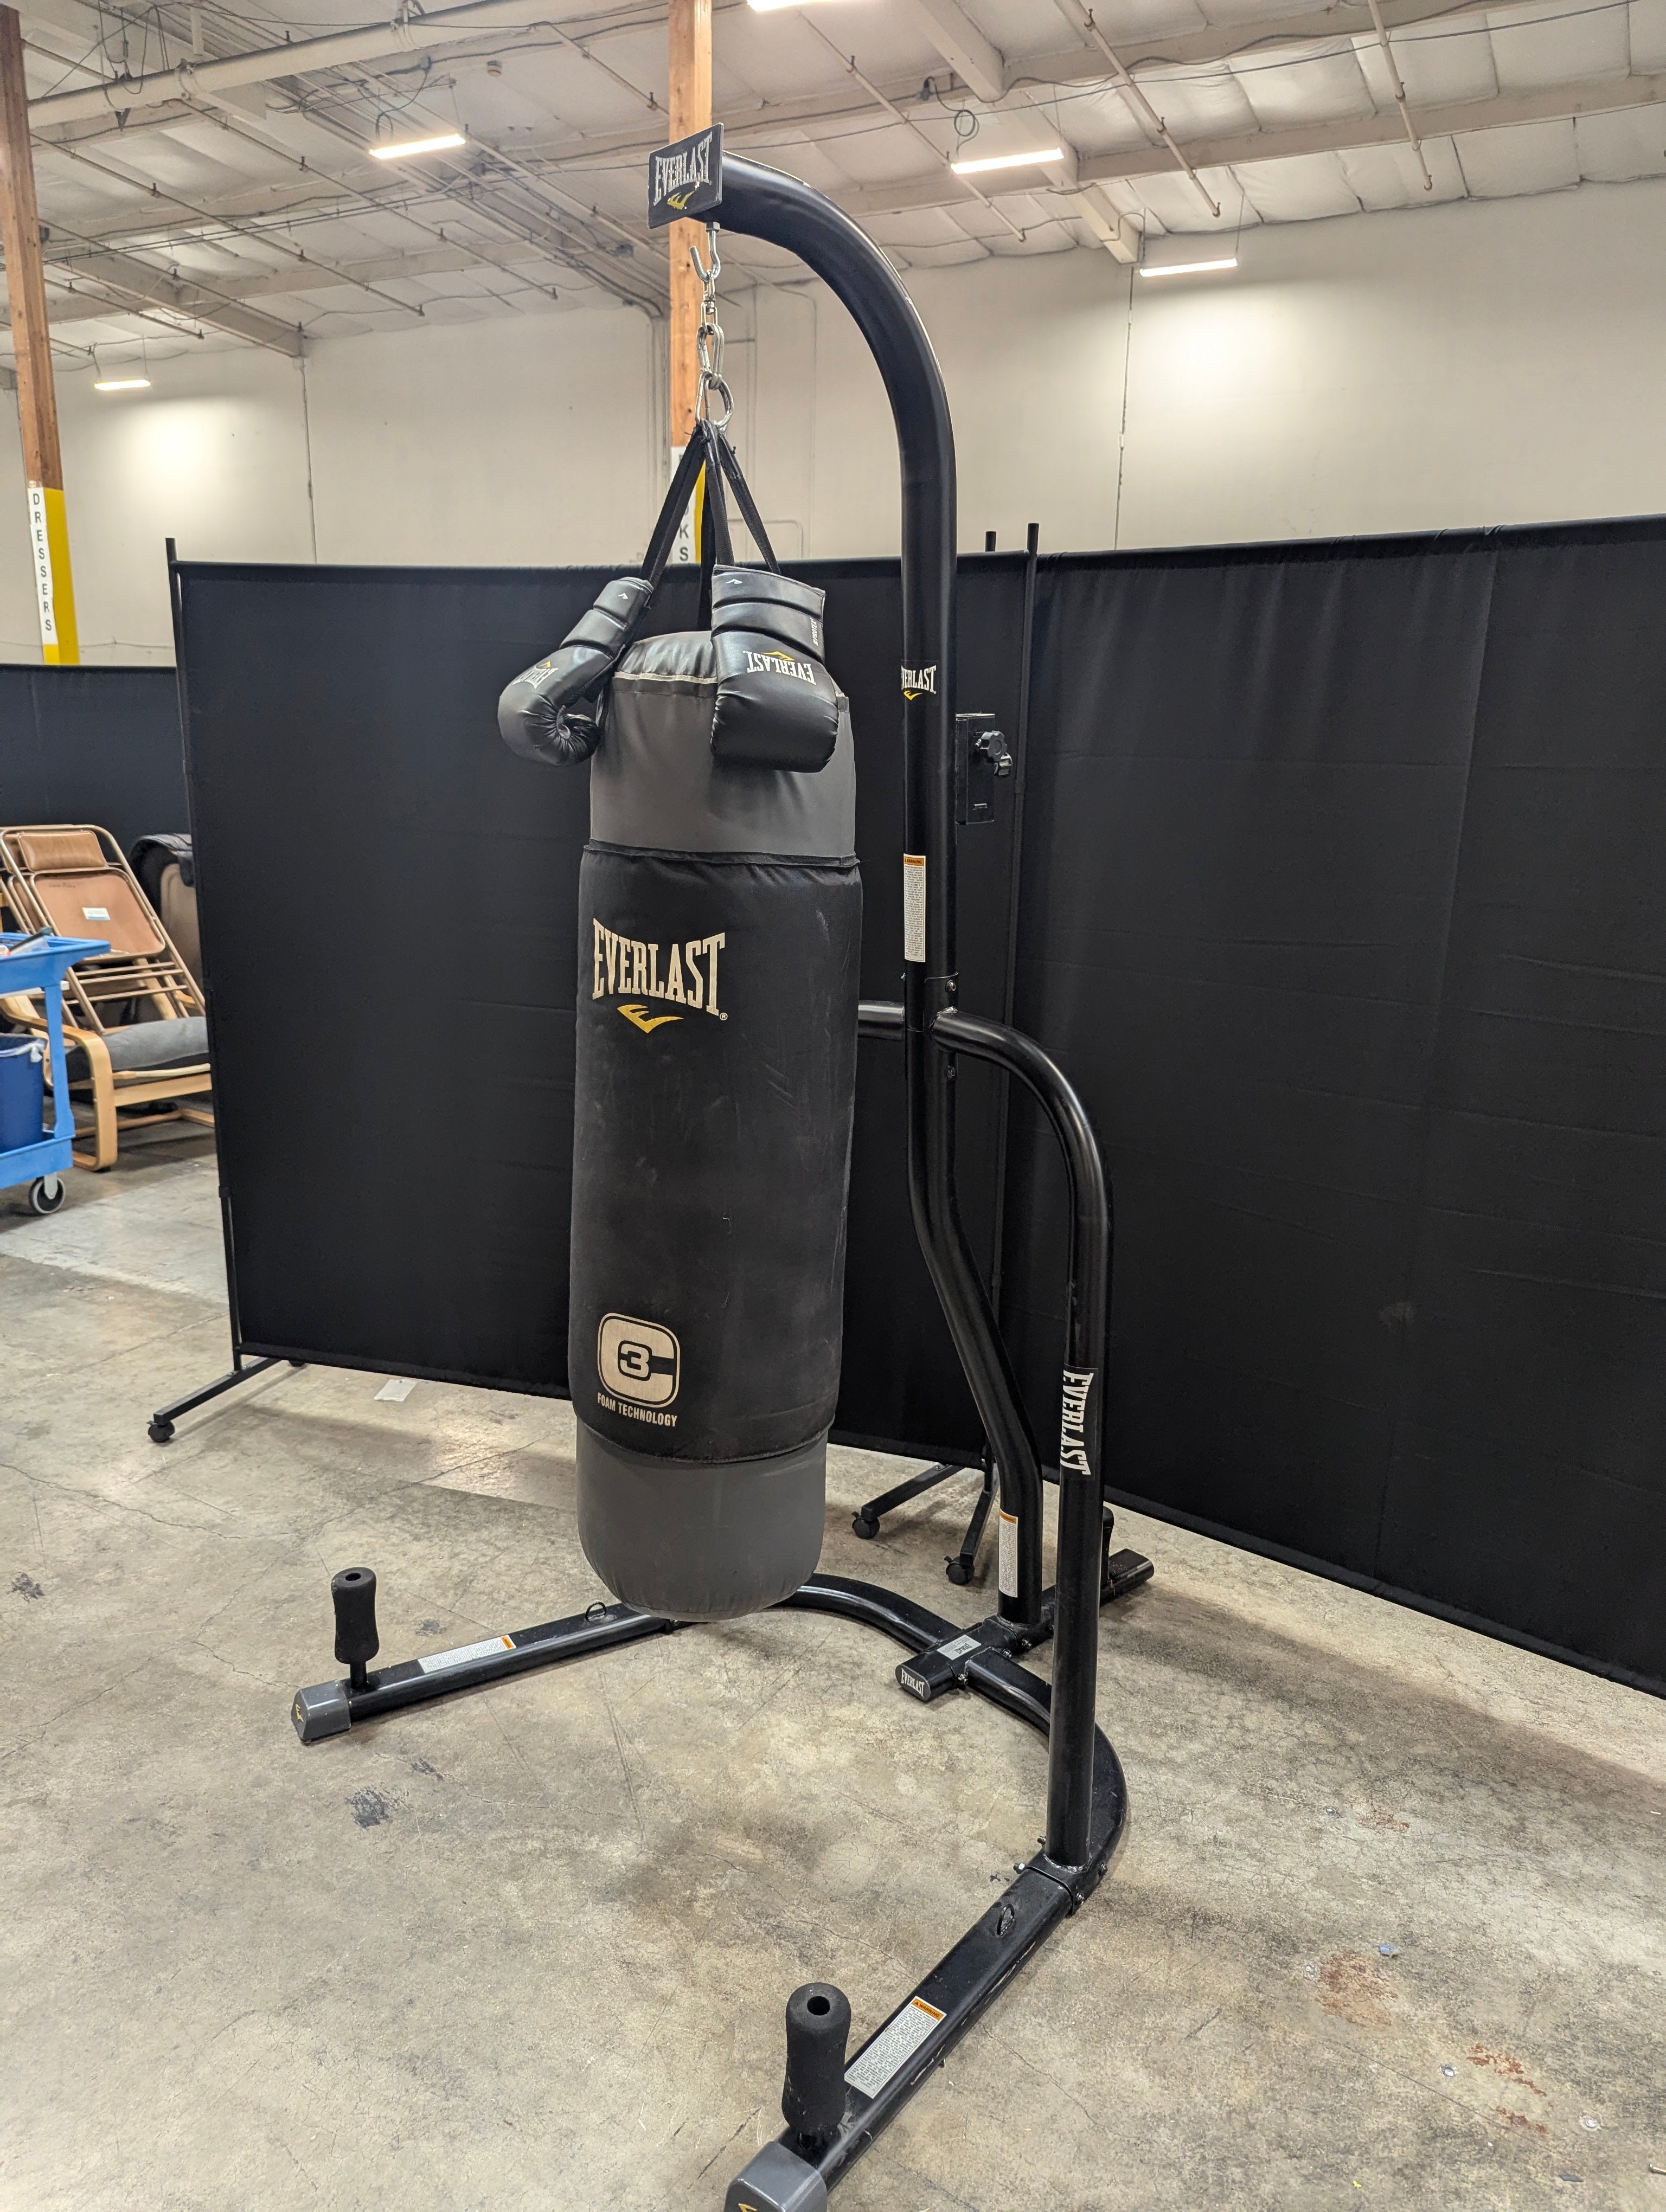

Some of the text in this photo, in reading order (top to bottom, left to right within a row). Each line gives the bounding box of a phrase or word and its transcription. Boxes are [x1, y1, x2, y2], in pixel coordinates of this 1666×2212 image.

[653, 131, 713, 207] EVERLAST
[33, 493, 53, 632] DRESSERS
[746, 651, 817, 686] EVERLAST
[901, 665, 937, 693] VERLAST
[592, 917, 726, 1017] EVERLAST
[597, 1392, 678, 1427] FOAM TECHNOLOGY
[1060, 1369, 1094, 1476] EVERLAST
[900, 1667, 925, 1699] EVERLAST
[919, 2003, 940, 2018] WARNING
